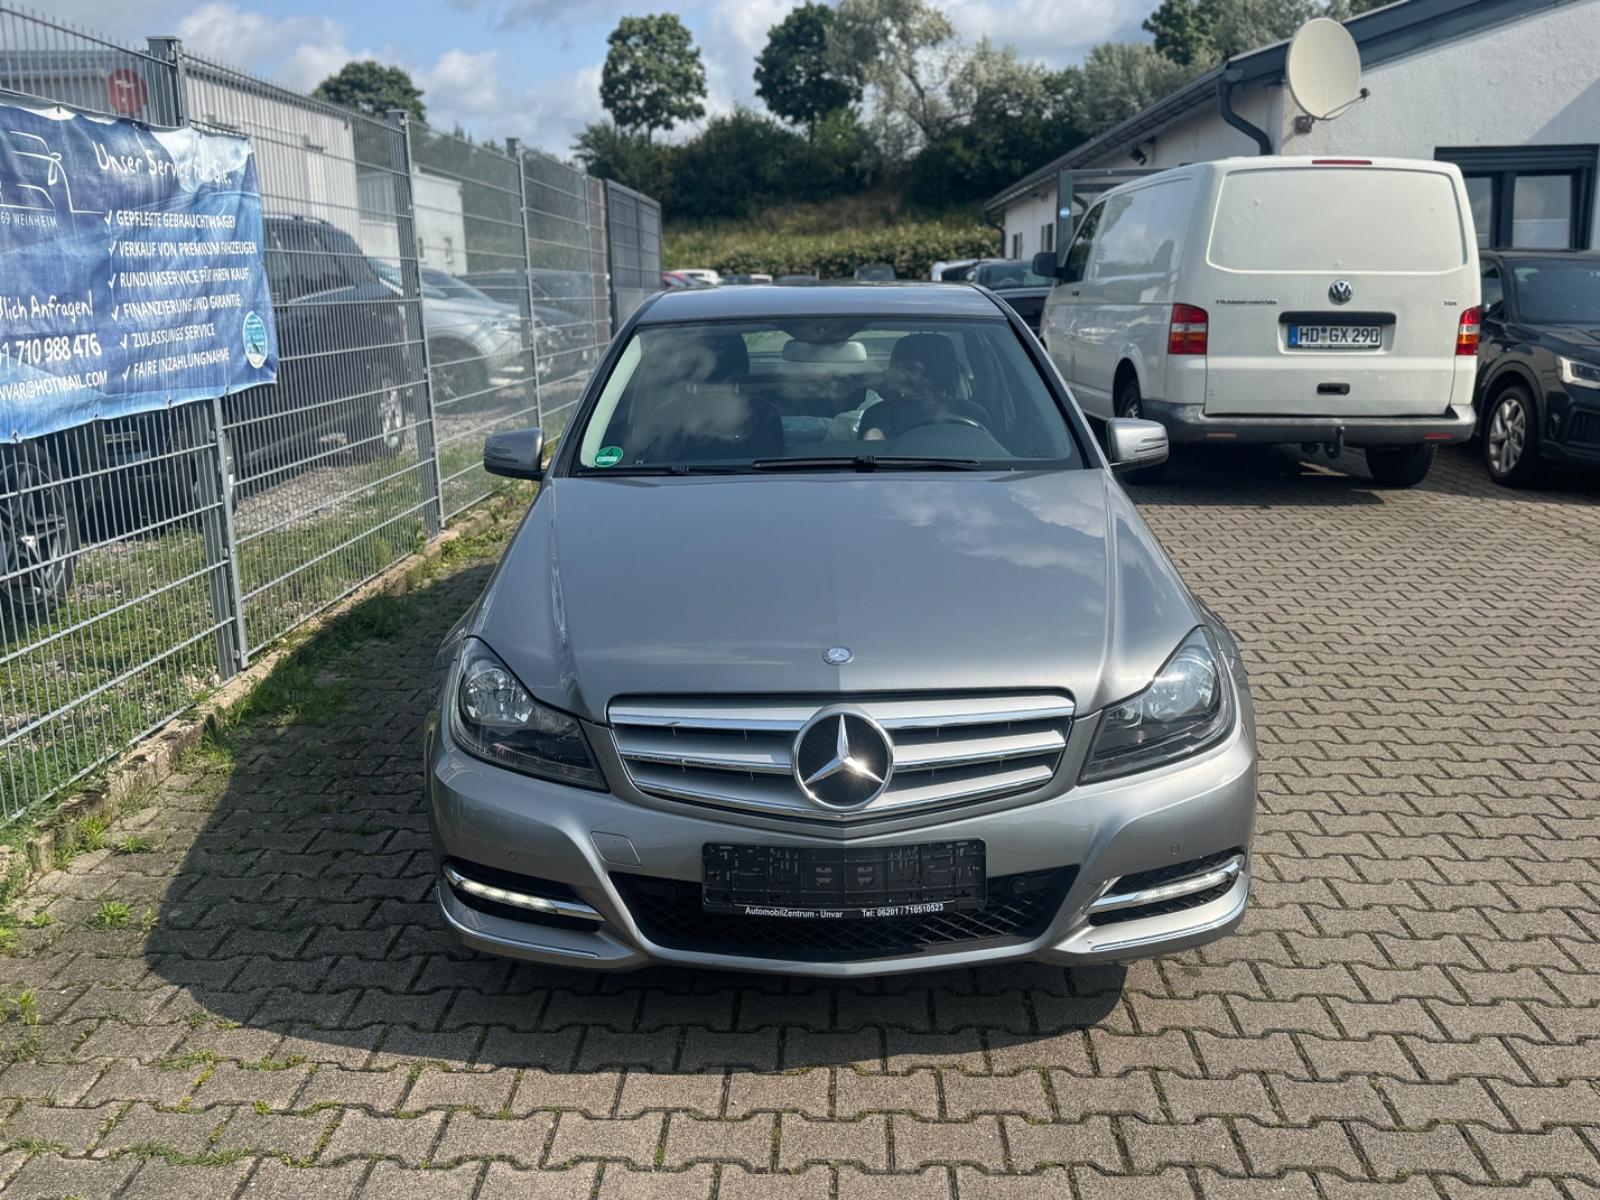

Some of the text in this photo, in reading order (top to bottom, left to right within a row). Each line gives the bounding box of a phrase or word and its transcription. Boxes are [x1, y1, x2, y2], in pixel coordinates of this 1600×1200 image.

[92, 140, 142, 174] Unser
[13, 212, 58, 228] WEINHEIM
[117, 210, 161, 227] GEPFLEGTE
[119, 241, 157, 257] VERKAUF
[158, 241, 178, 257] VON
[179, 242, 220, 257] PREMIUM
[120, 270, 199, 288] RUNDUMSERVICE
[231, 267, 250, 281] KAUF
[30, 289, 93, 325] Anfragen!
[123, 298, 193, 319] FINANZIERUNG
[132, 323, 216, 348] ZULASSUNGS SERVICE
[1299, 327, 1379, 343] HD GX 290
[16, 339, 41, 365] 710
[44, 335, 72, 363] 988
[73, 332, 103, 359] 476
[134, 359, 157, 378] FAIRE
[745, 906, 815, 918] AutomobilZentrum
[862, 908, 875, 918] Tel:
[876, 906, 898, 917] 06201
